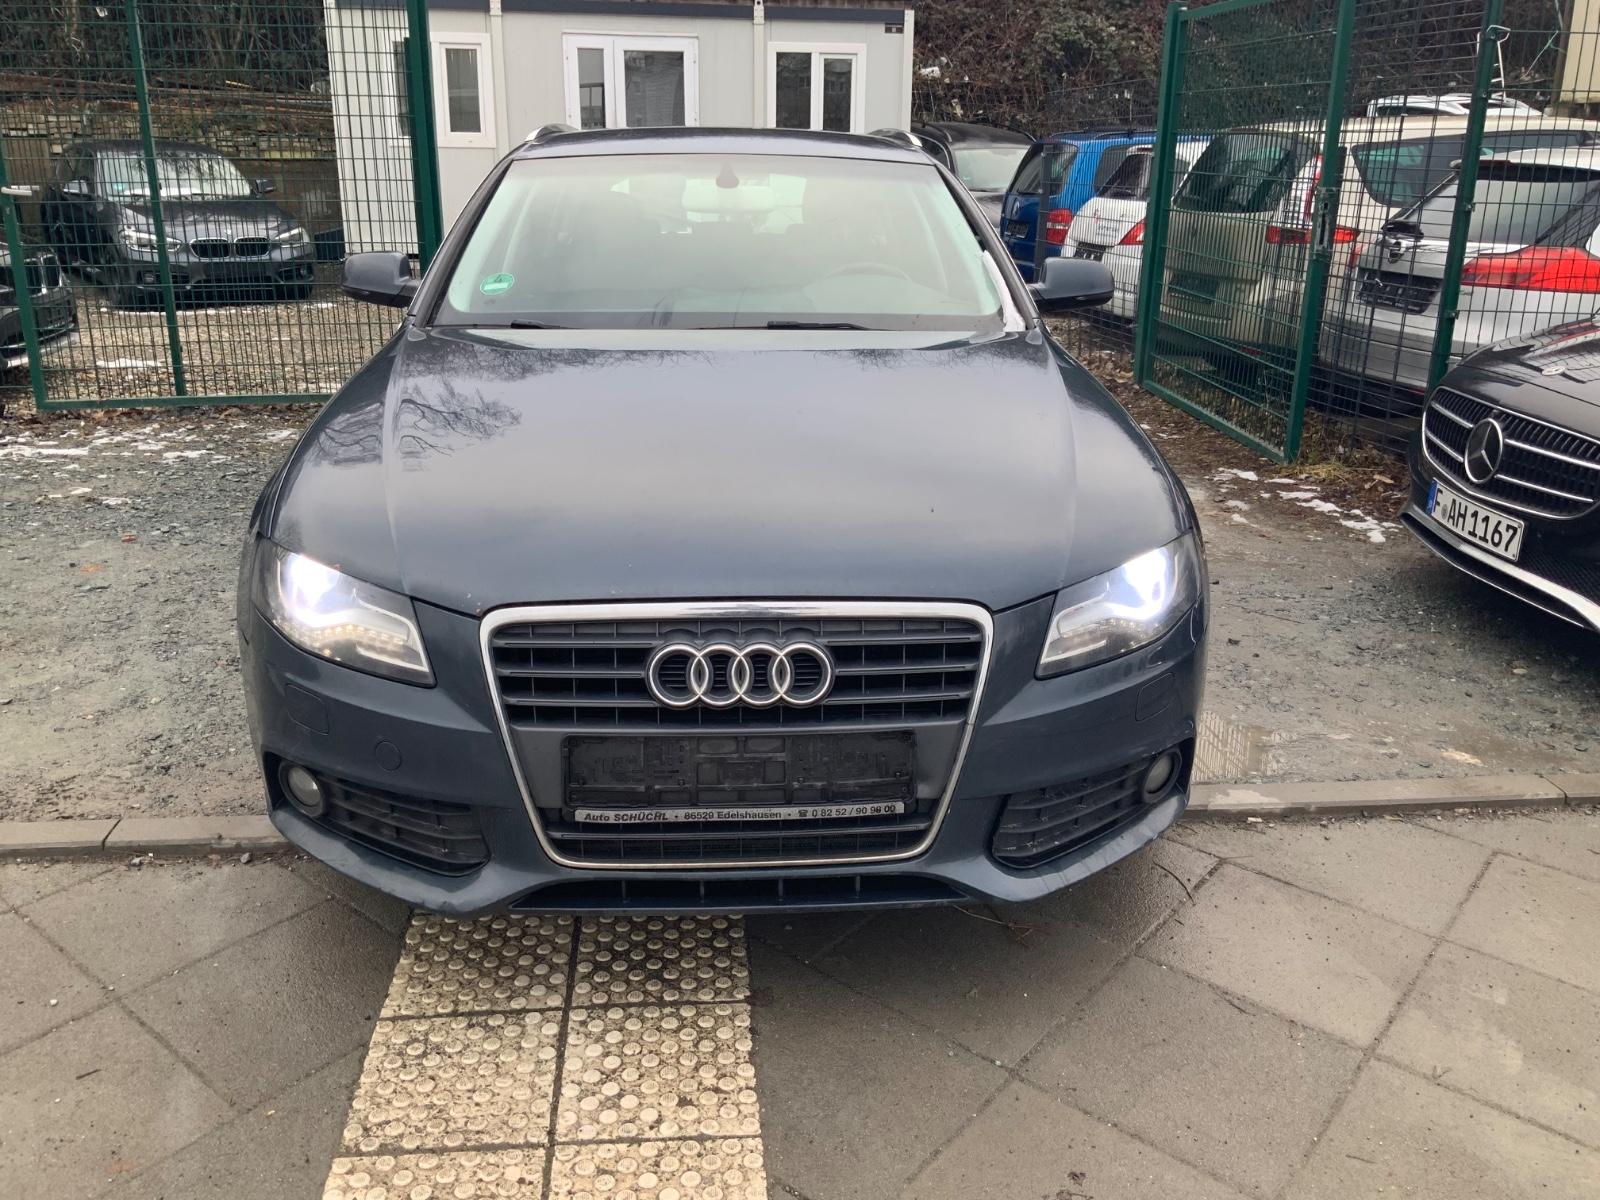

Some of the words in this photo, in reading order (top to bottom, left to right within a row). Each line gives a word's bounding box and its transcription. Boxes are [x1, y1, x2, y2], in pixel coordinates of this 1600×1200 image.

[1433, 487, 1443, 513] F
[584, 813, 610, 821] Auto
[717, 810, 782, 819] Edelshausen
